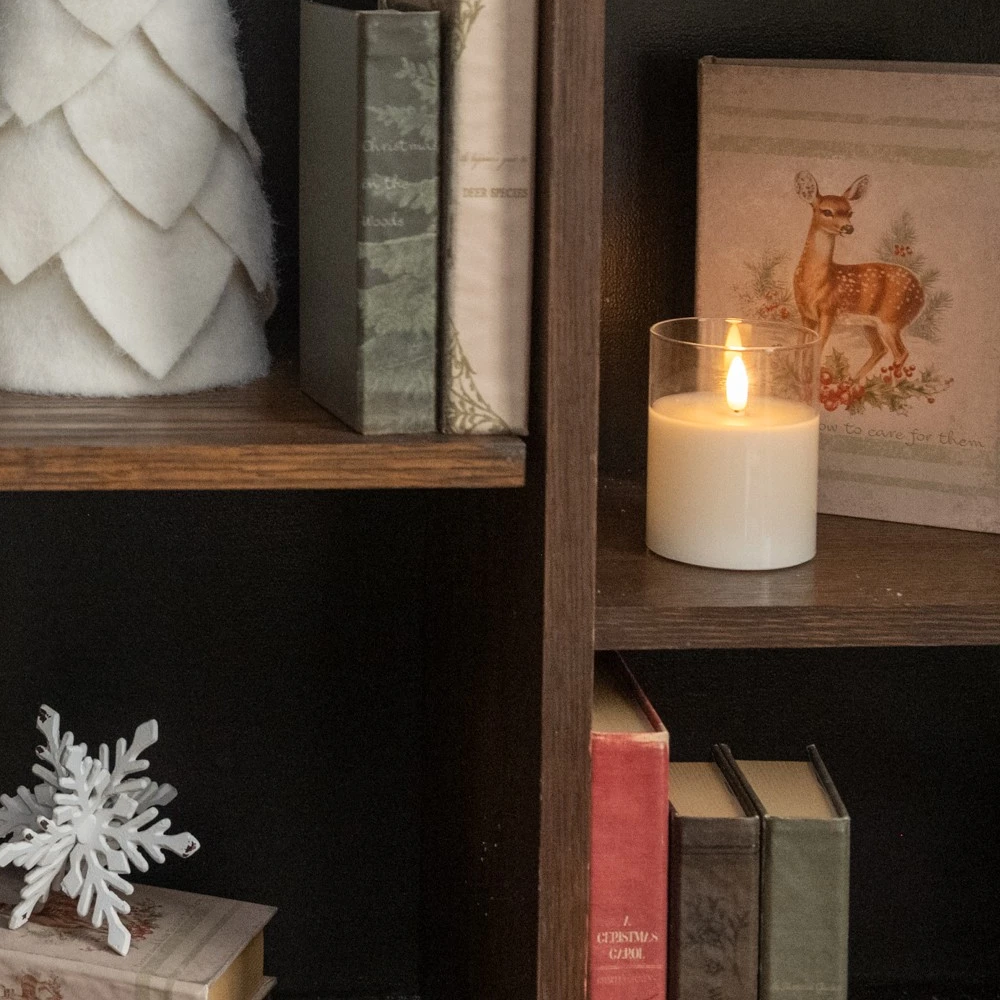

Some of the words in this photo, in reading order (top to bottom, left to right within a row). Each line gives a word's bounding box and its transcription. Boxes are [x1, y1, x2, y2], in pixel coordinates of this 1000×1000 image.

[819, 422, 838, 433] ow
[843, 422, 863, 435] to
[867, 427, 904, 440] care
[904, 428, 936, 447] for
[938, 430, 985, 448] them
